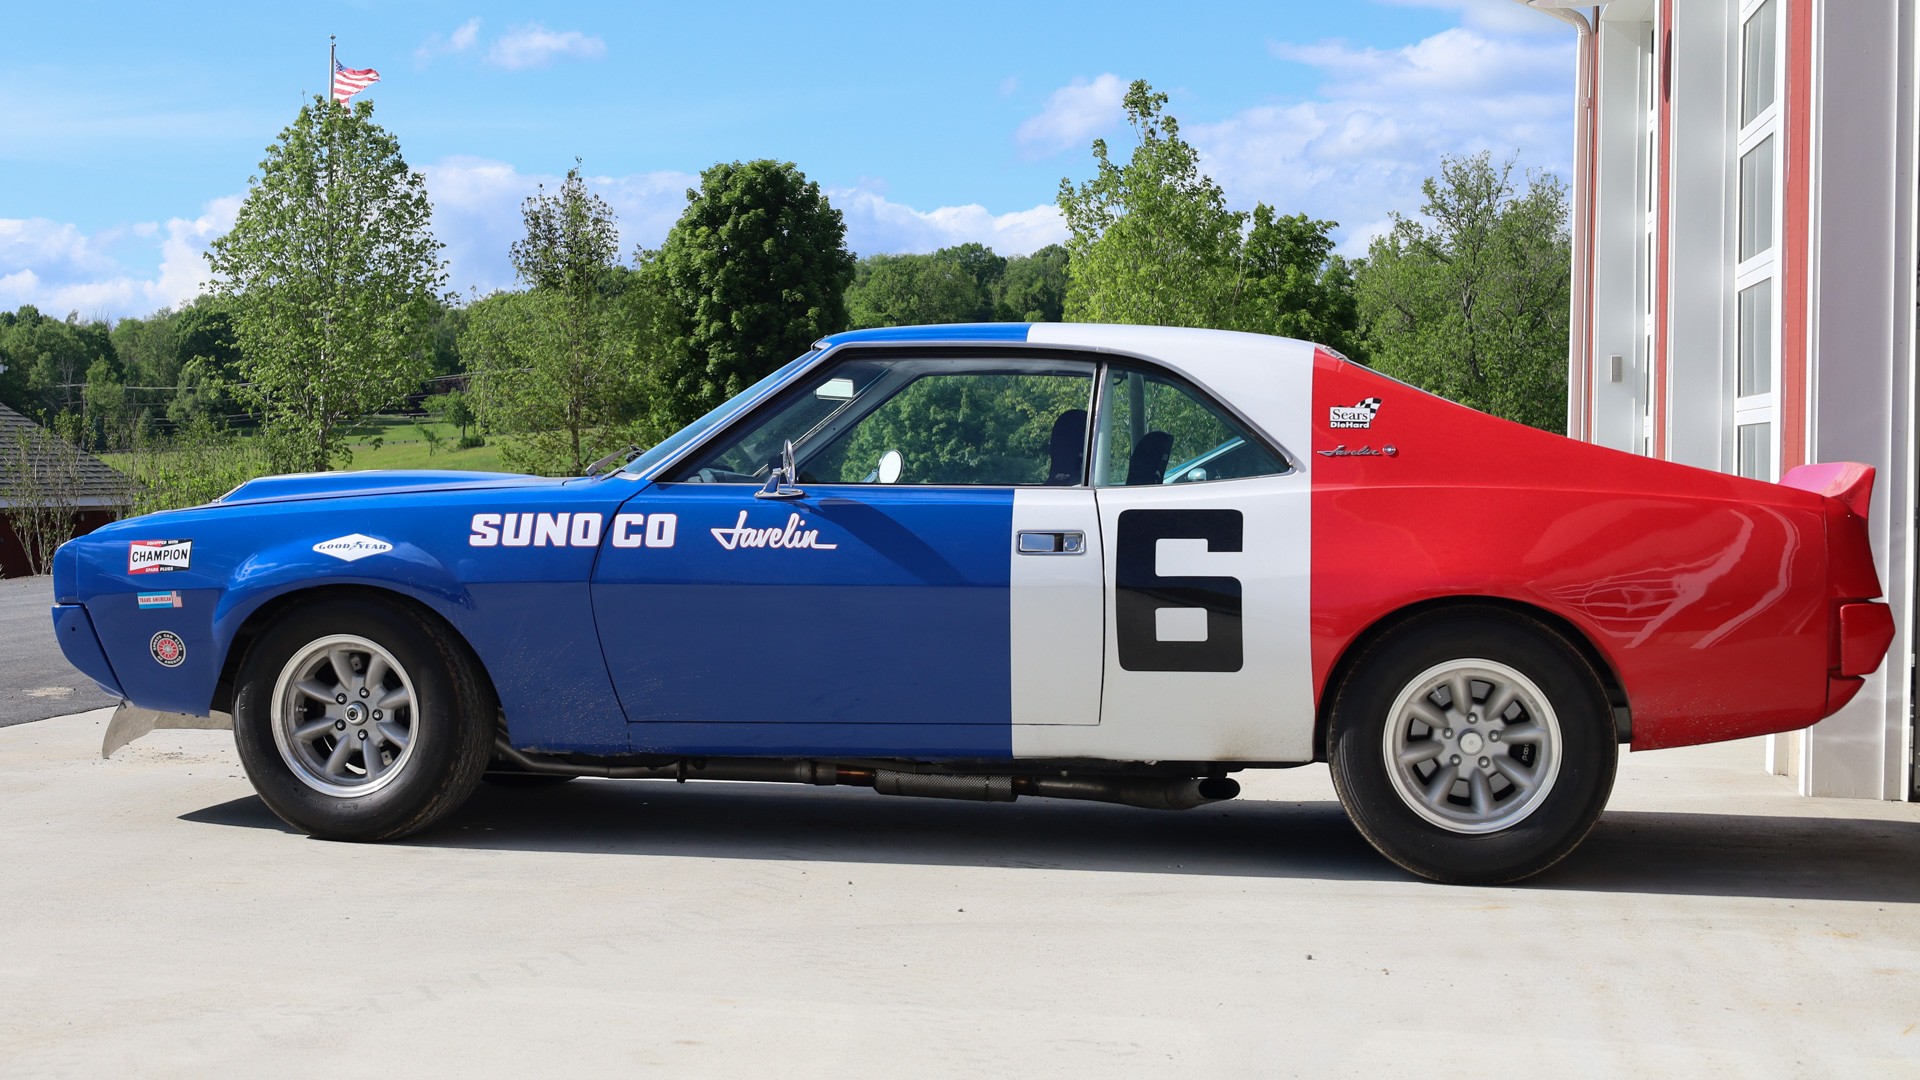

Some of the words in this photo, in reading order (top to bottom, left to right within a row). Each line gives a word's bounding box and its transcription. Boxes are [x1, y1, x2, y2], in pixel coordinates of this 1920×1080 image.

[1332, 409, 1368, 420] Sears
[1316, 445, 1381, 456] Javelin
[711, 510, 838, 550] Javelin
[132, 549, 188, 562] CHAMPION
[1116, 509, 1243, 672] 6
[153, 635, 162, 650] SPORTS
[175, 639, 183, 651] CLUB
[164, 655, 182, 664] AMERICA
